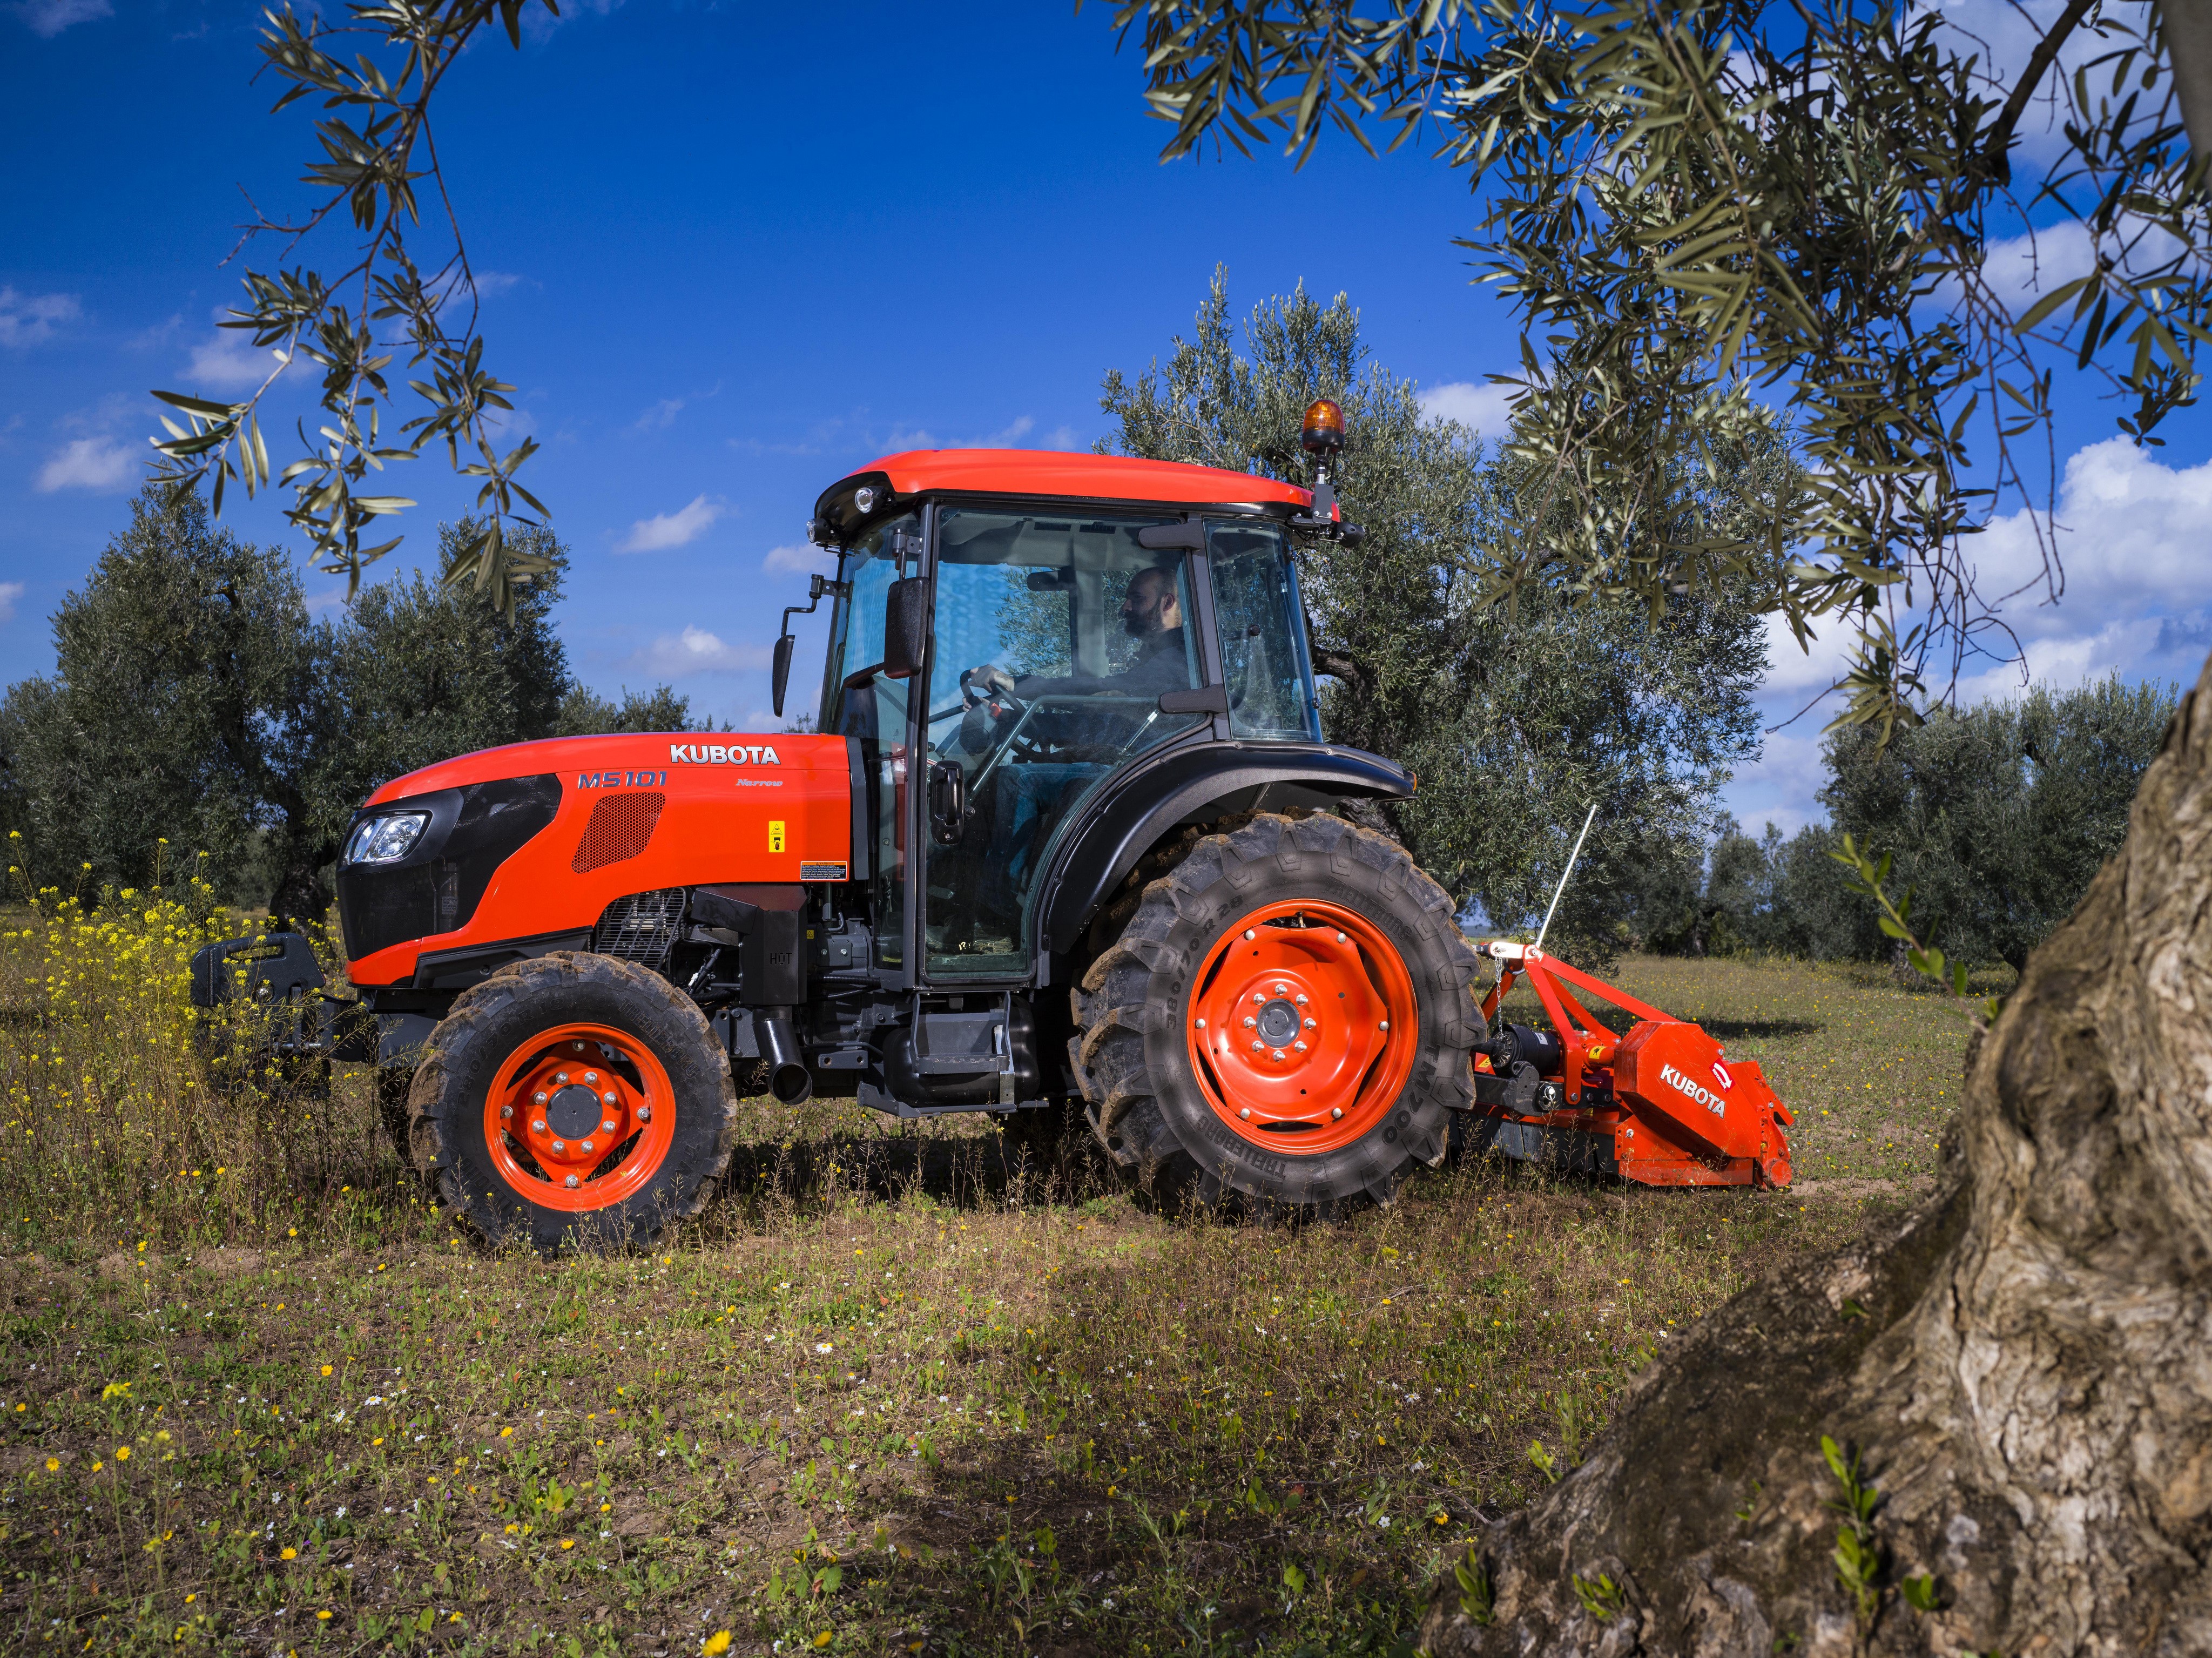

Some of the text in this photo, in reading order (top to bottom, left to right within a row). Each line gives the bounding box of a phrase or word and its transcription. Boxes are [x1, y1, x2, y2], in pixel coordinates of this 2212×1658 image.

[670, 744, 781, 765] KUBOTA
[578, 771, 667, 789] M5101
[735, 779, 783, 787] Narrow
[1324, 875, 1412, 940] TRELLEBORG
[770, 953, 792, 965] HOT
[1166, 894, 1244, 1029] 380/70 R 28
[539, 997, 565, 1015] 18
[618, 996, 702, 1079] TRELLEBORG
[1382, 1043, 1441, 1145] TM700
[1660, 1063, 1726, 1119] KUBOTA
[1712, 1068, 1727, 1089] ROTATION
[1196, 1116, 1286, 1180] TRELLEBORG
